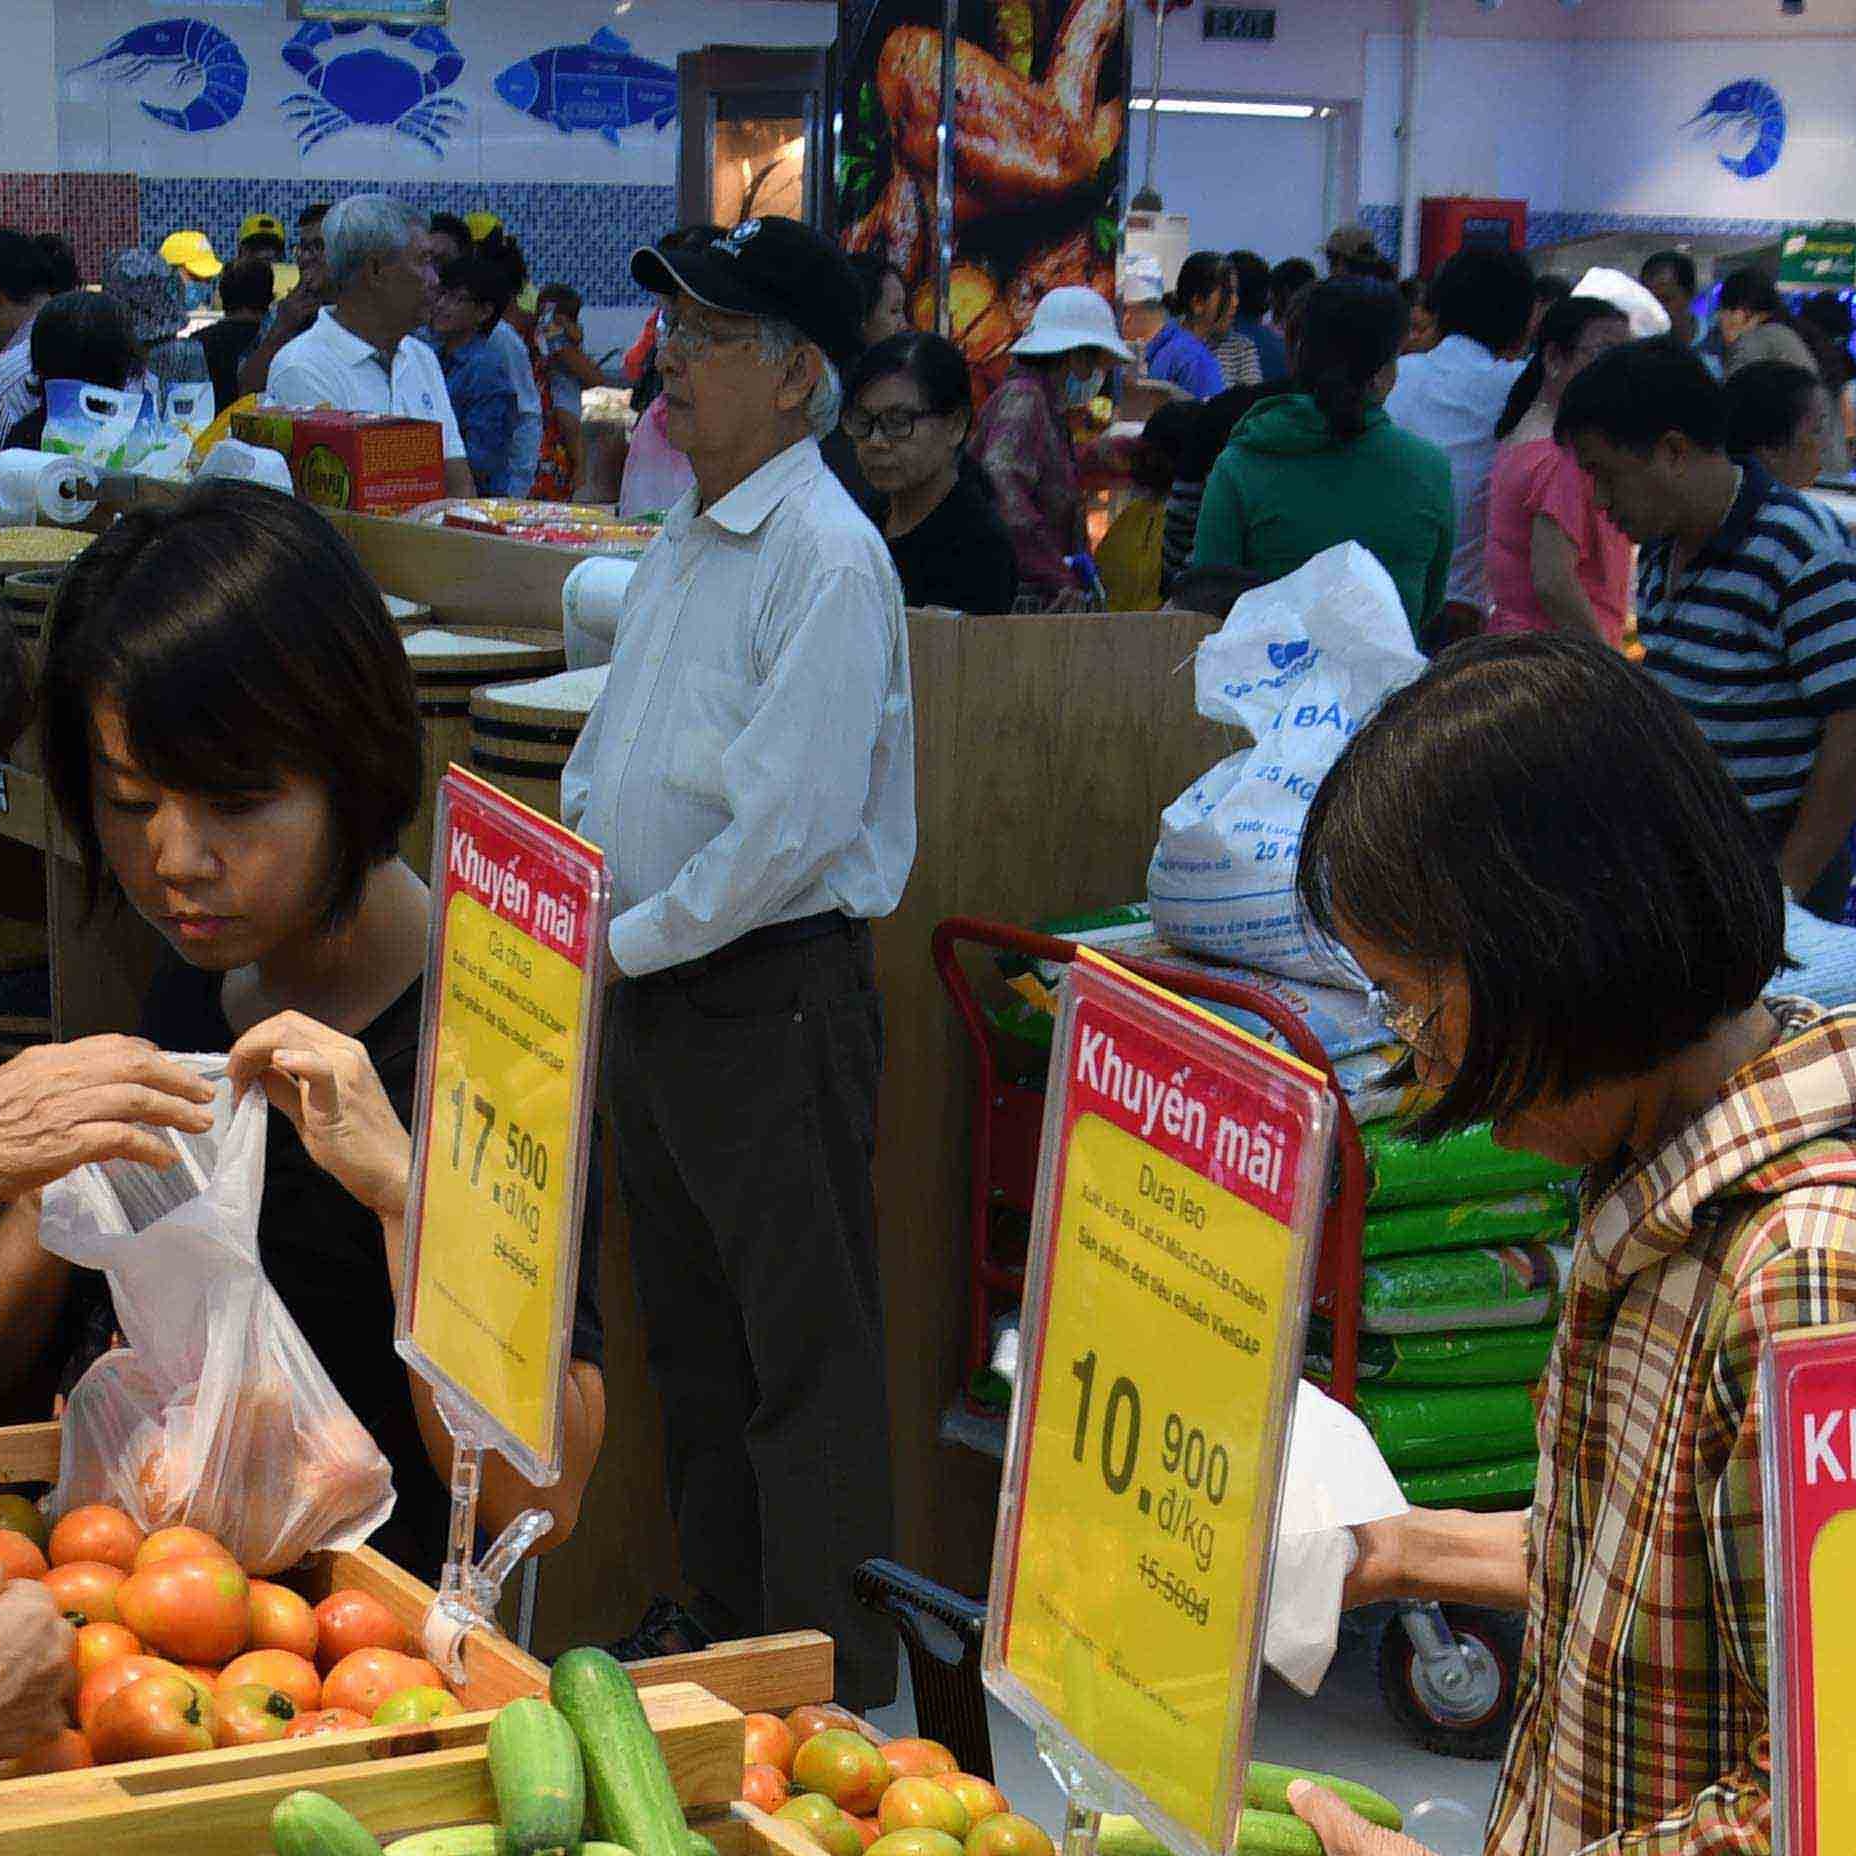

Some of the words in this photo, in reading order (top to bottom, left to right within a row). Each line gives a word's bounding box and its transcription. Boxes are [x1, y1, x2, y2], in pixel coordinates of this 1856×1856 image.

[450, 827, 531, 918] Khuyến
[535, 891, 578, 948] mãi
[506, 1121, 548, 1190] 500
[1077, 1024, 1207, 1150] Khuyến
[1215, 1115, 1286, 1195] mãi
[1179, 1186, 1206, 1231] leo
[1073, 1350, 1153, 1515] 10.
[1162, 1412, 1229, 1506] 900
[1158, 1487, 1215, 1573] đ/kg
